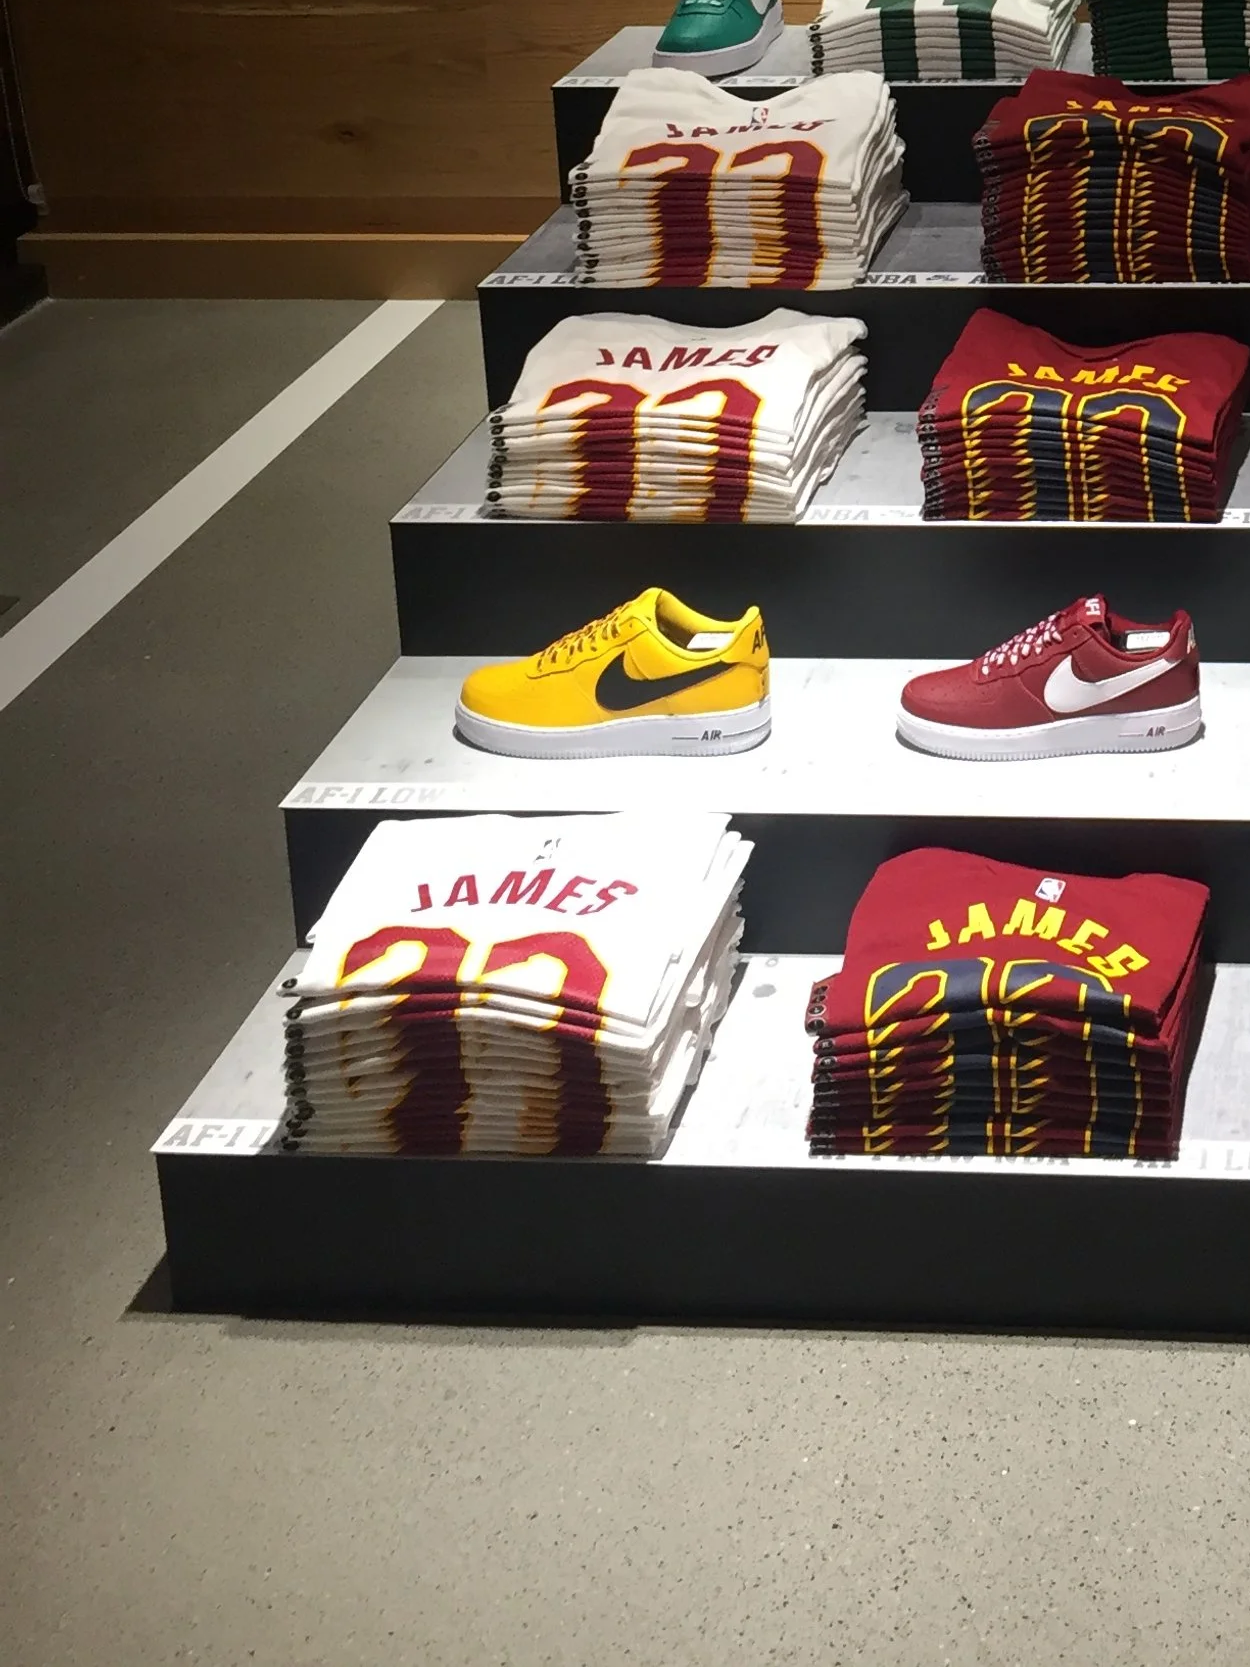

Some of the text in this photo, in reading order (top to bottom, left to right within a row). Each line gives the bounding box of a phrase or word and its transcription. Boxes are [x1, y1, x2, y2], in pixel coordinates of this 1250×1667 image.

[864, 275, 918, 285] NBA
[701, 730, 723, 741] AIR
[1146, 726, 1166, 737] AIR
[289, 787, 448, 804] AF-1 LOW
[410, 867, 639, 916] JAMES
[927, 898, 1150, 980] JAMES
[162, 1124, 246, 1148] AF-1
